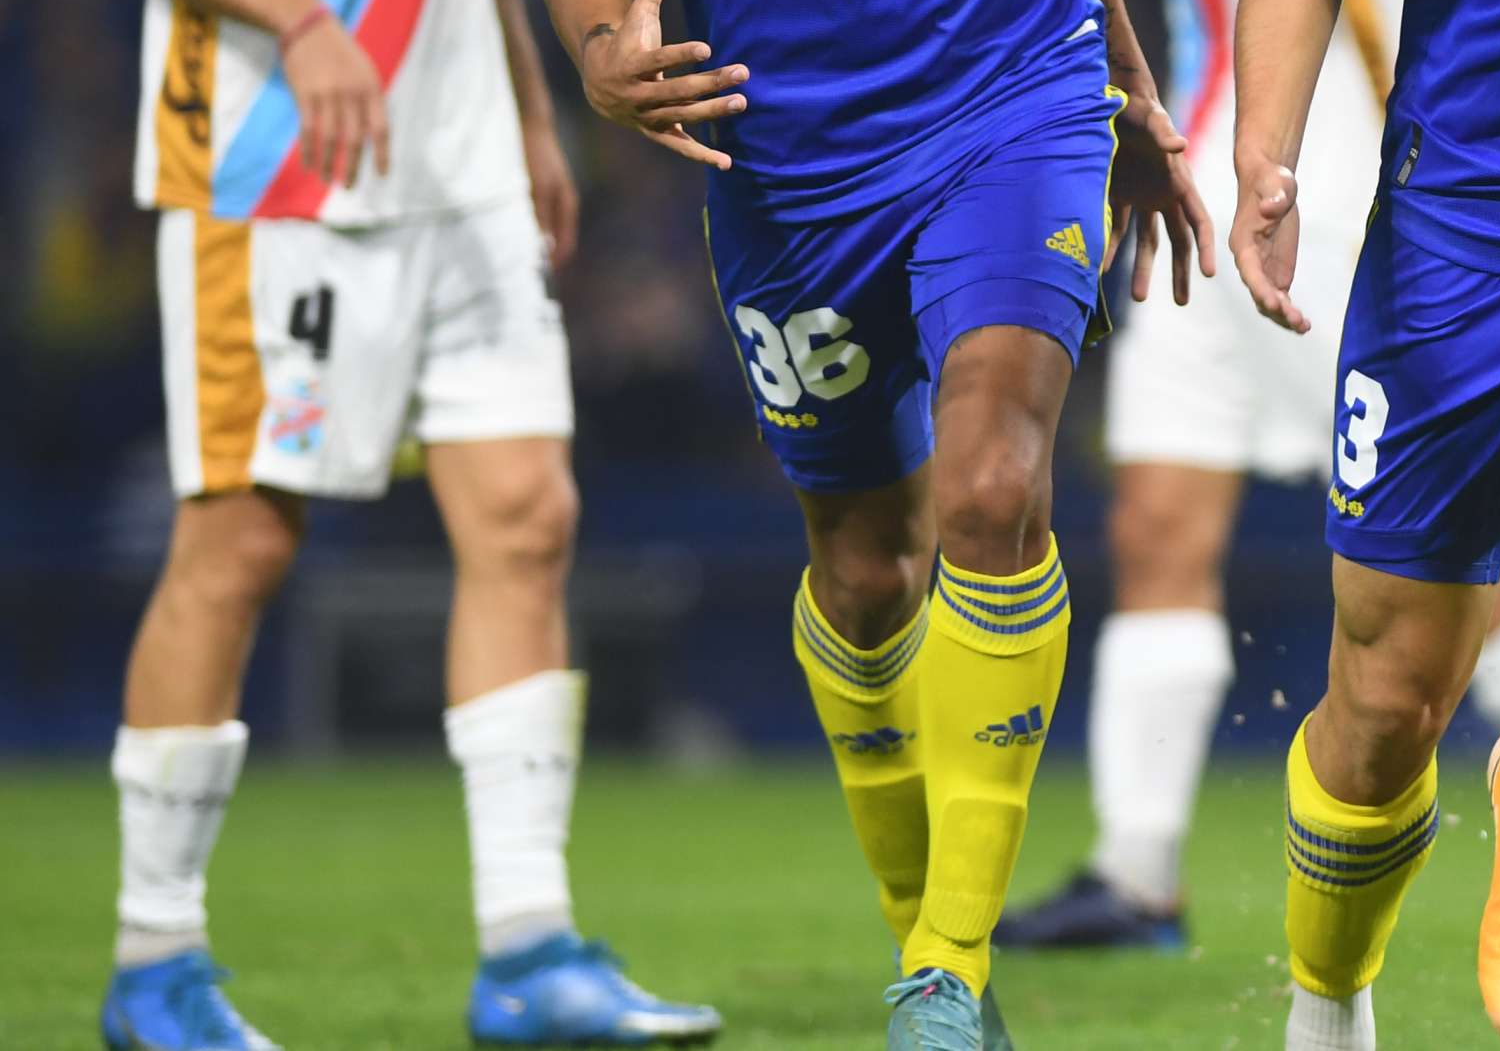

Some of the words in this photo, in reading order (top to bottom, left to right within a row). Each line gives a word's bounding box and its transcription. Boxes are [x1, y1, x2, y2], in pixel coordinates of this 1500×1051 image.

[289, 283, 334, 361] 4
[735, 304, 871, 408] 36
[1337, 369, 1390, 490] 3
